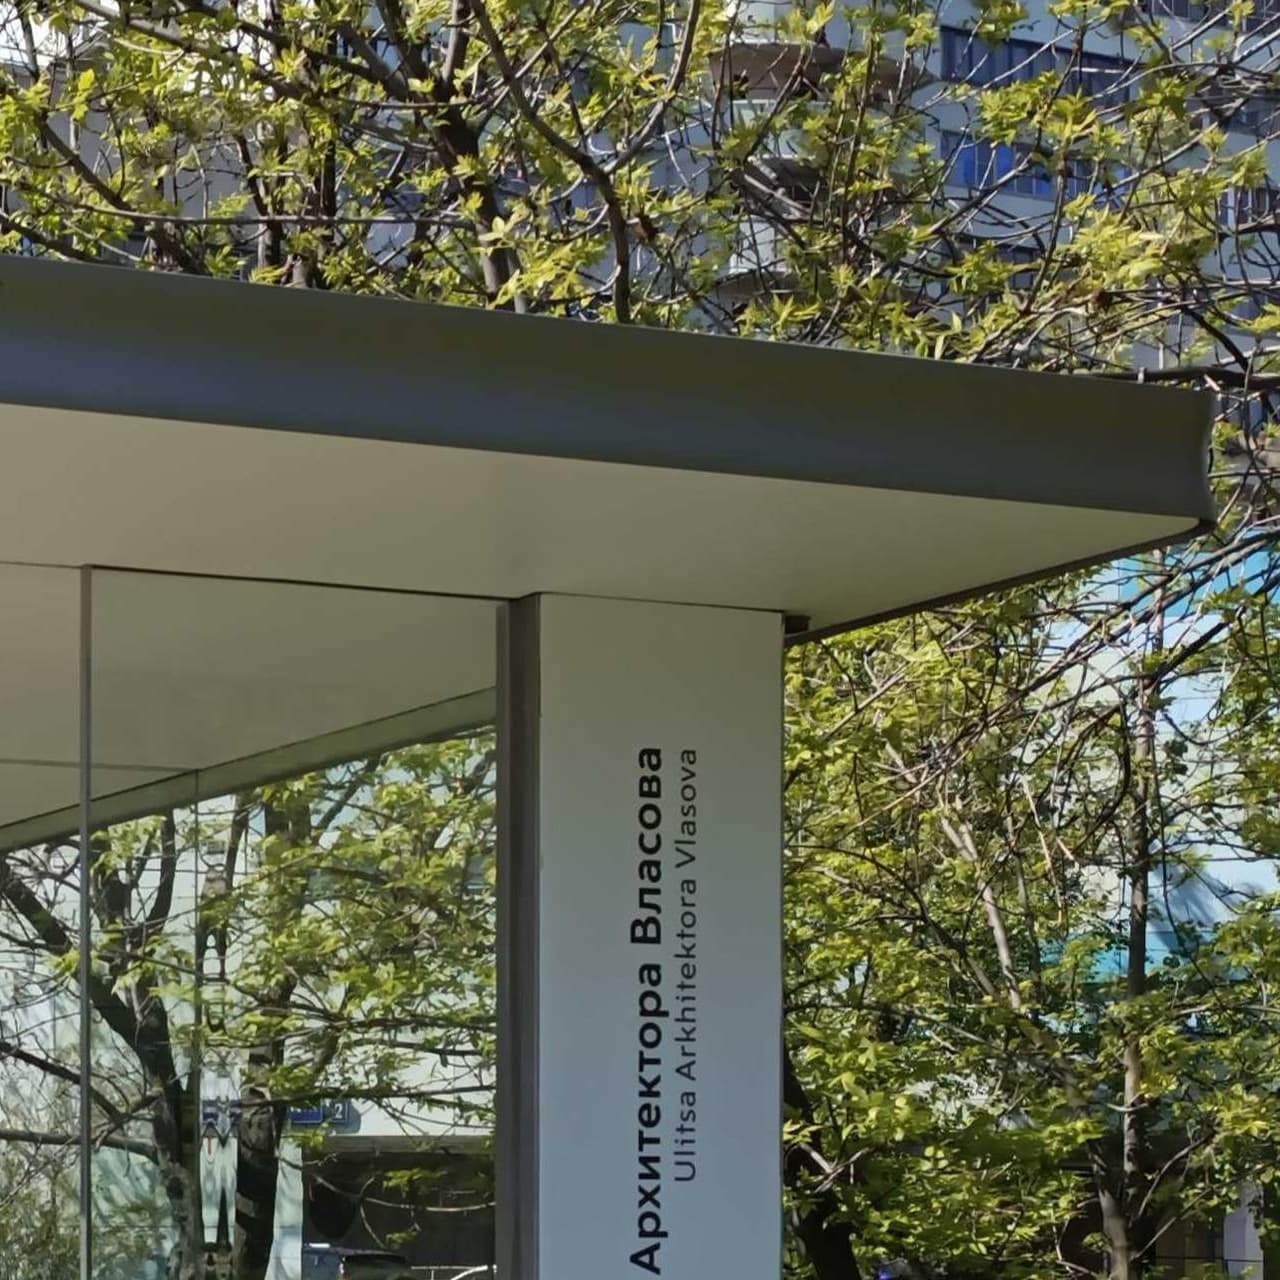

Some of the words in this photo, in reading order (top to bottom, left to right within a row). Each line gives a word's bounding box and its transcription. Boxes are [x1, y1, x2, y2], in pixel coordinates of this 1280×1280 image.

[630, 748, 662, 944] Власова
[674, 749, 696, 868] Vlasova
[674, 880, 696, 1081] Arkhitektora
[630, 963, 669, 1275] Архитектора
[674, 1092, 696, 1181] Ulitsa
